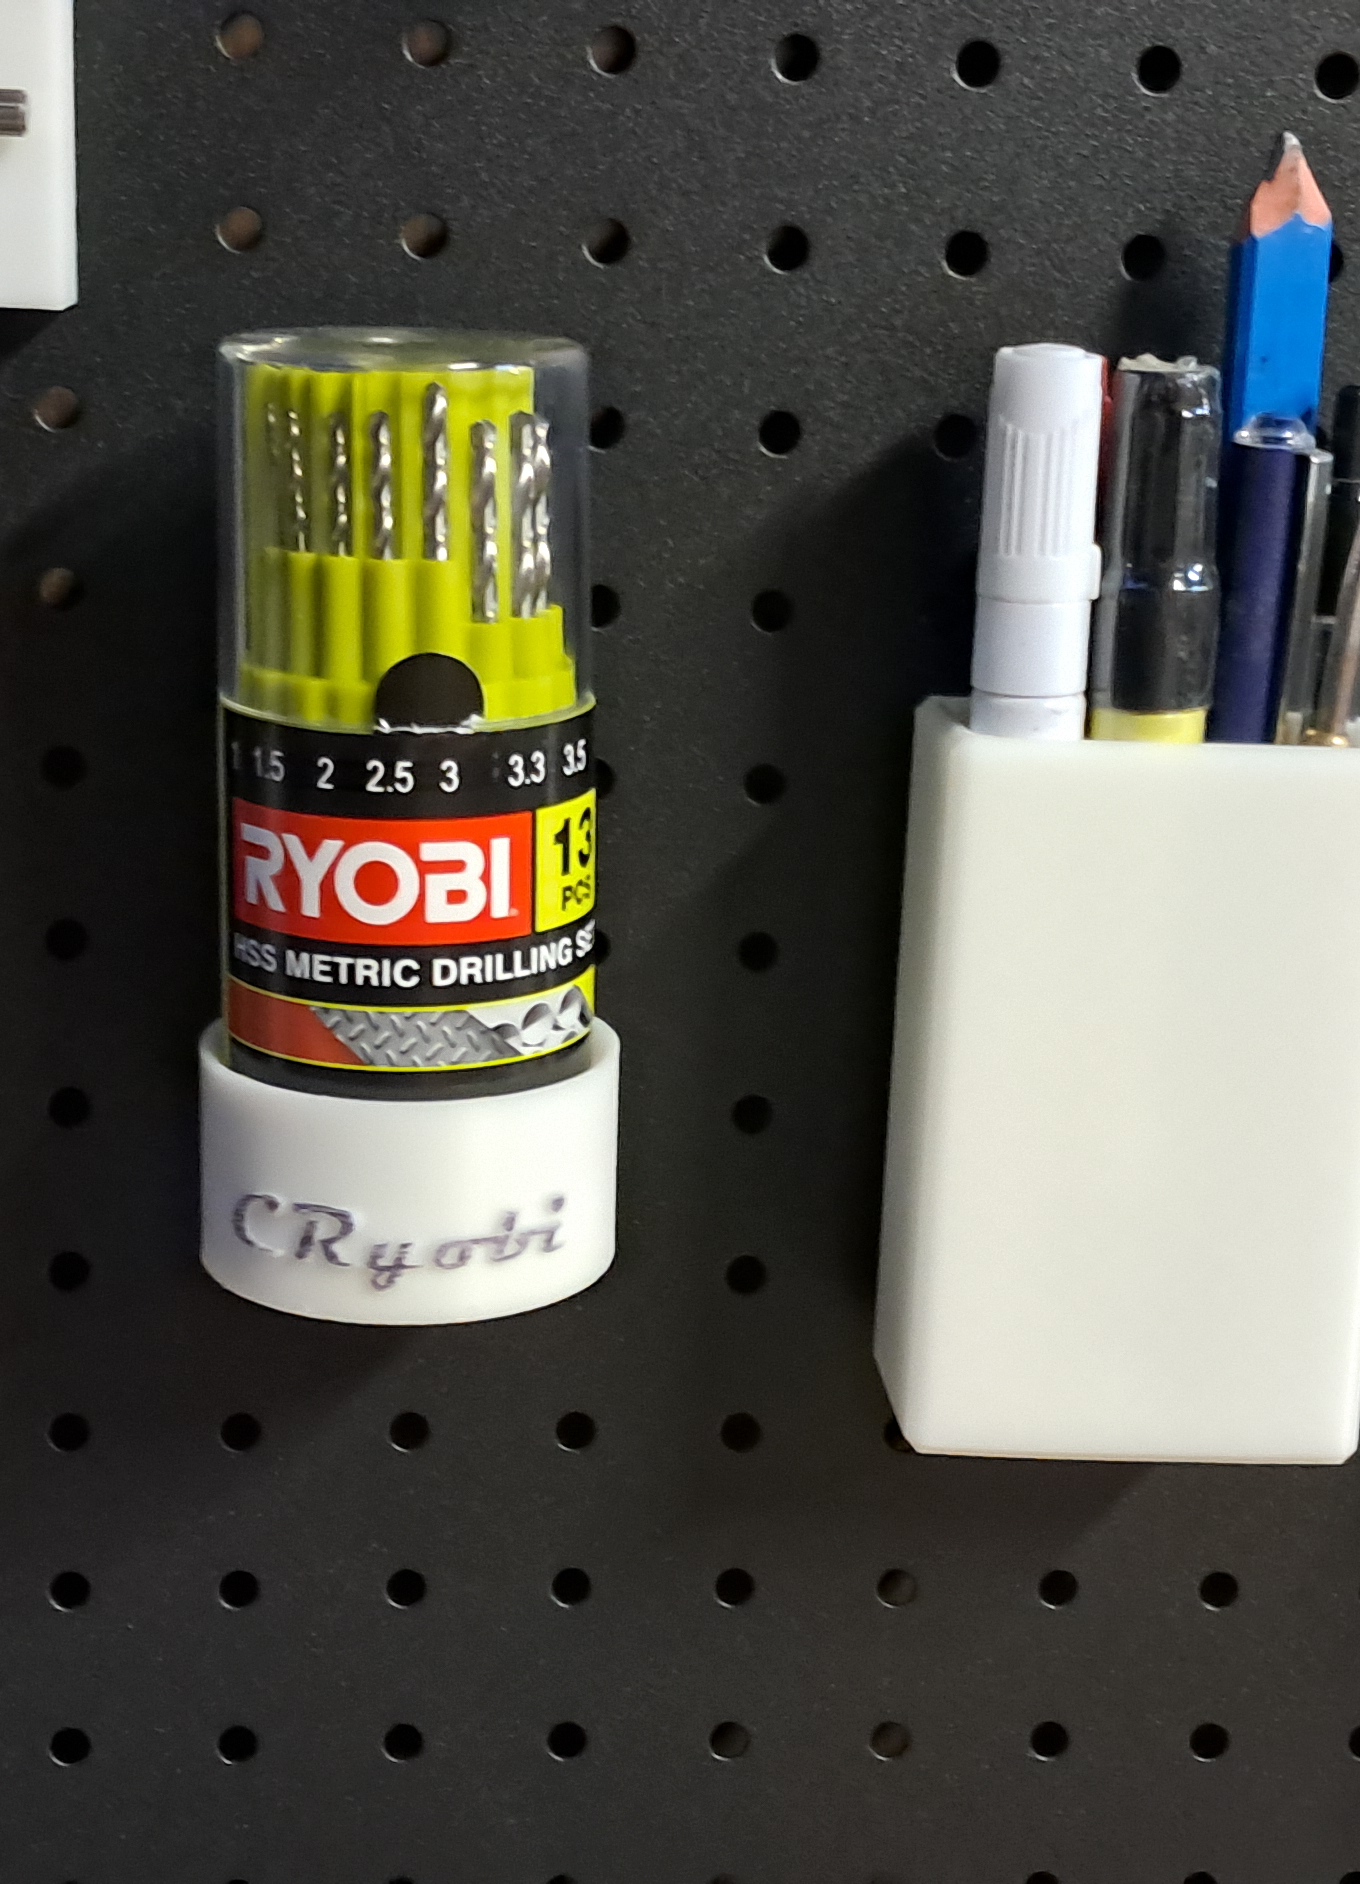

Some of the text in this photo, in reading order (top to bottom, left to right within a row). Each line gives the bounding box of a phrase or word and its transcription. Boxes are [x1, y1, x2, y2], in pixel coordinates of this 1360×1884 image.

[316, 756, 335, 790] 2
[365, 759, 415, 794] 2.5
[438, 760, 461, 793] 3
[507, 750, 546, 788] 3.3
[562, 738, 587, 776] 3.5
[239, 822, 513, 926] RYOBI
[554, 806, 592, 876] 13
[232, 932, 278, 973] HSS
[284, 949, 422, 989] METRIC
[432, 937, 573, 987] DRILLING
[231, 1194, 570, 1293] CRyobi
